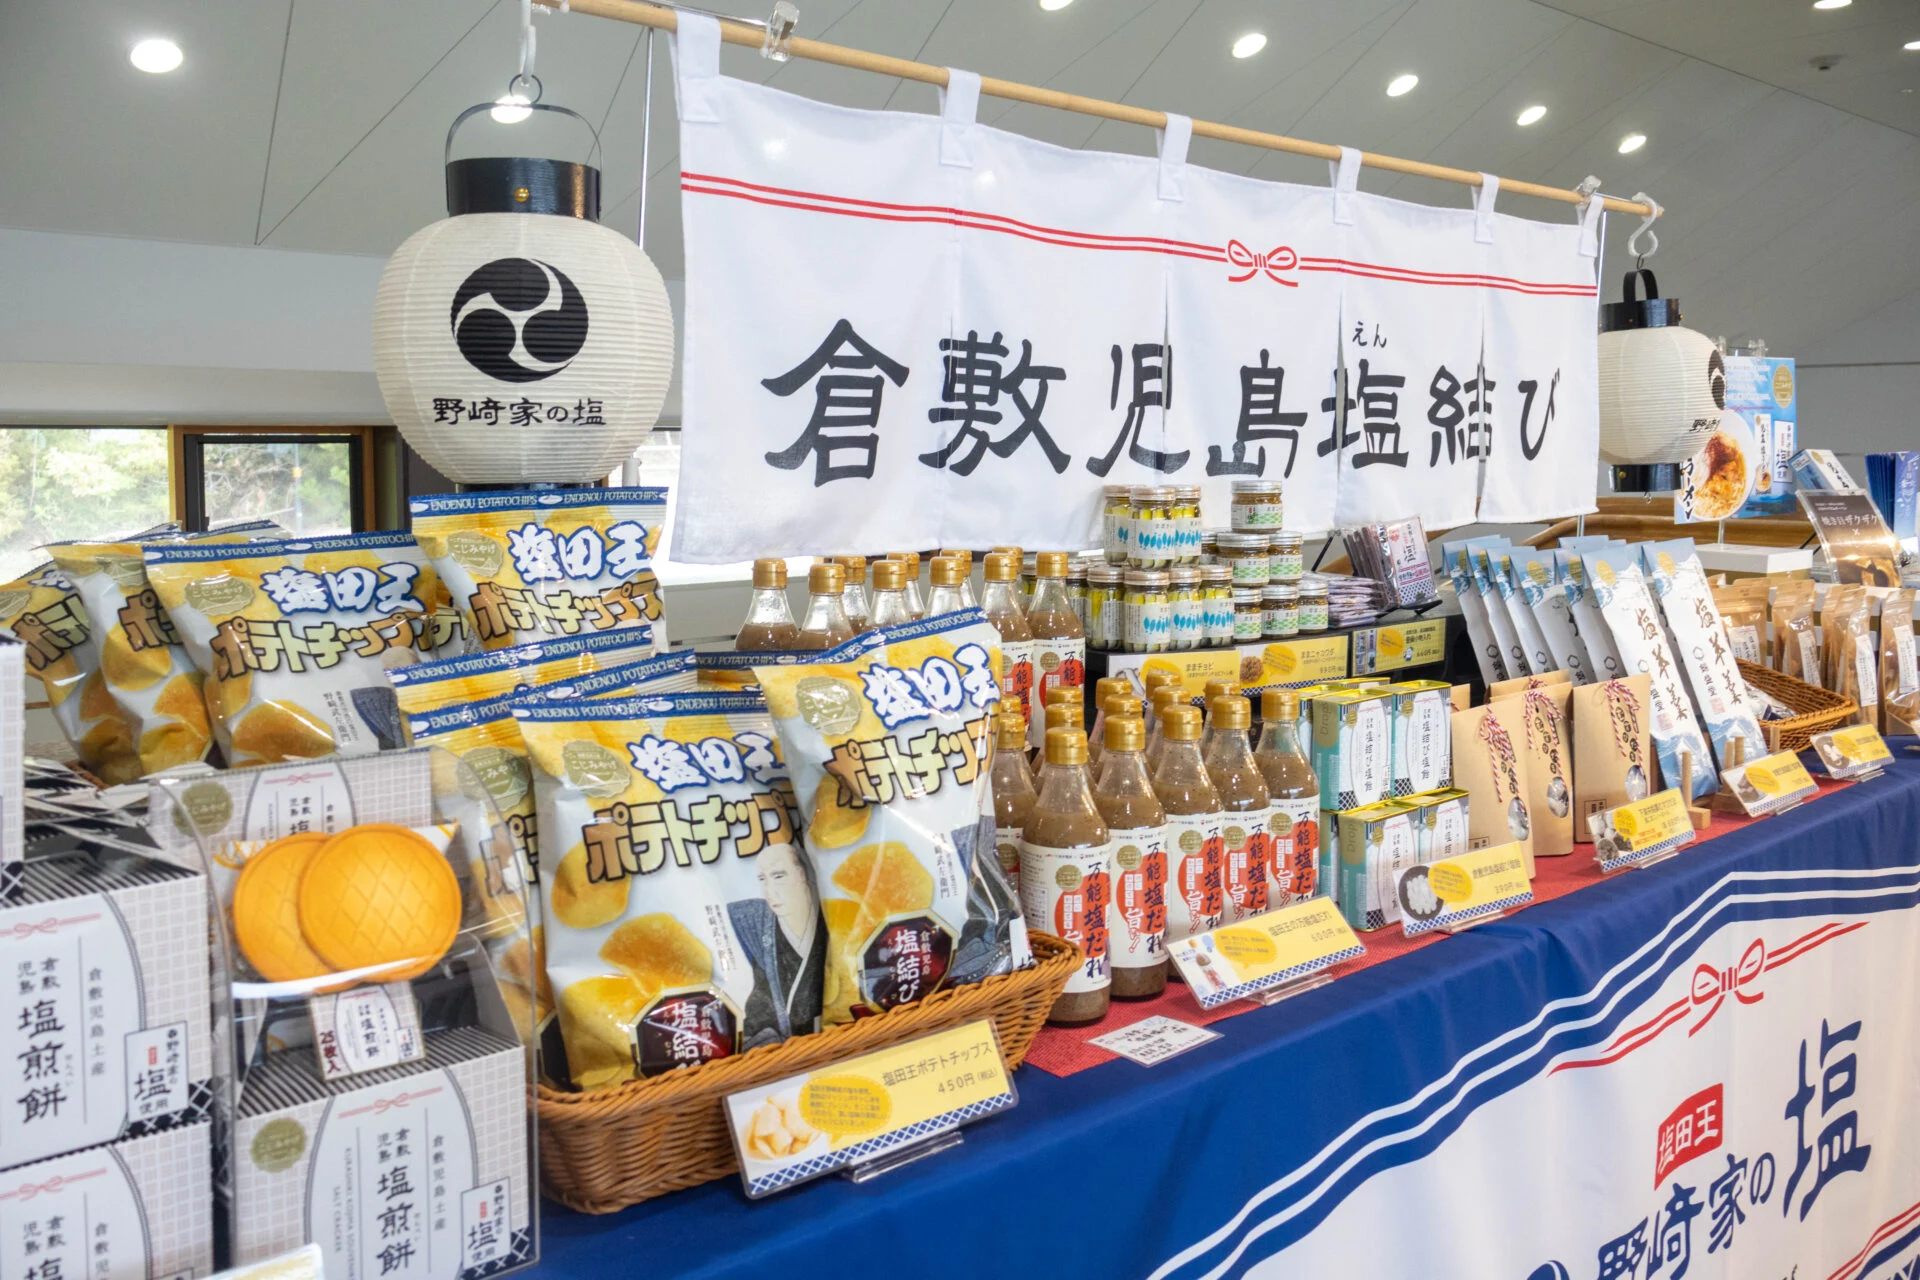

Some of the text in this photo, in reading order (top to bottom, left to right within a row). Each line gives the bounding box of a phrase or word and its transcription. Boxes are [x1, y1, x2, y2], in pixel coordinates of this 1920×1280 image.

[1350, 320, 1388, 349] えん
[760, 317, 1562, 489] 倉敷児島塩結び
[430, 494, 538, 511] ENDENOU POTATOCHIPS
[562, 490, 659, 503] ENDENOU POTATOCHIPS
[164, 544, 285, 560] ENDENOU POTATOCHIPS
[312, 538, 359, 550] ENDENOU
[505, 520, 653, 585] 塩田王
[260, 561, 427, 615] 塩田王
[469, 578, 665, 641] ポテトチップス
[927, 611, 980, 633] POTATOCHIPS
[541, 630, 642, 656] ENDENOU POTATOCHIPS
[408, 664, 455, 680] ENDENOU
[574, 676, 621, 696] ENDENOU
[622, 656, 684, 682] POTATOCHIPS
[857, 643, 1001, 731] 塩田王
[531, 701, 649, 718] ENDENOU POTATOCHIPS
[674, 699, 718, 711] ENDENOU
[626, 731, 794, 794] 塩田王
[823, 712, 999, 809] ポテトチップ
[582, 788, 802, 884] ポテトチップ
[1143, 841, 1164, 954] 万能塩だれ
[1204, 826, 1222, 931] 万能塩だれ
[1083, 861, 1105, 979] 万能塩だれ
[16, 960, 37, 997] 児島
[40, 956, 61, 991] 倉敷
[894, 928, 921, 1004] 塩結び
[87, 967, 107, 1077] 倉敷児島土産
[16, 998, 68, 1125] 塩煎餅
[882, 1041, 993, 1087] 塩田王ポテトチップス
[133, 1067, 172, 1101] 塩
[937, 1071, 976, 1095] 450円
[376, 1132, 393, 1165] 児島
[394, 1127, 412, 1159] 倉敷
[1657, 1098, 1719, 1174] 塩田王
[432, 1134, 447, 1232] 倉敷児島土産
[23, 1220, 42, 1256] 児島
[46, 1215, 67, 1249] 倉敷
[375, 1165, 416, 1277] 塩煎餅
[467, 1220, 499, 1251] 塩
